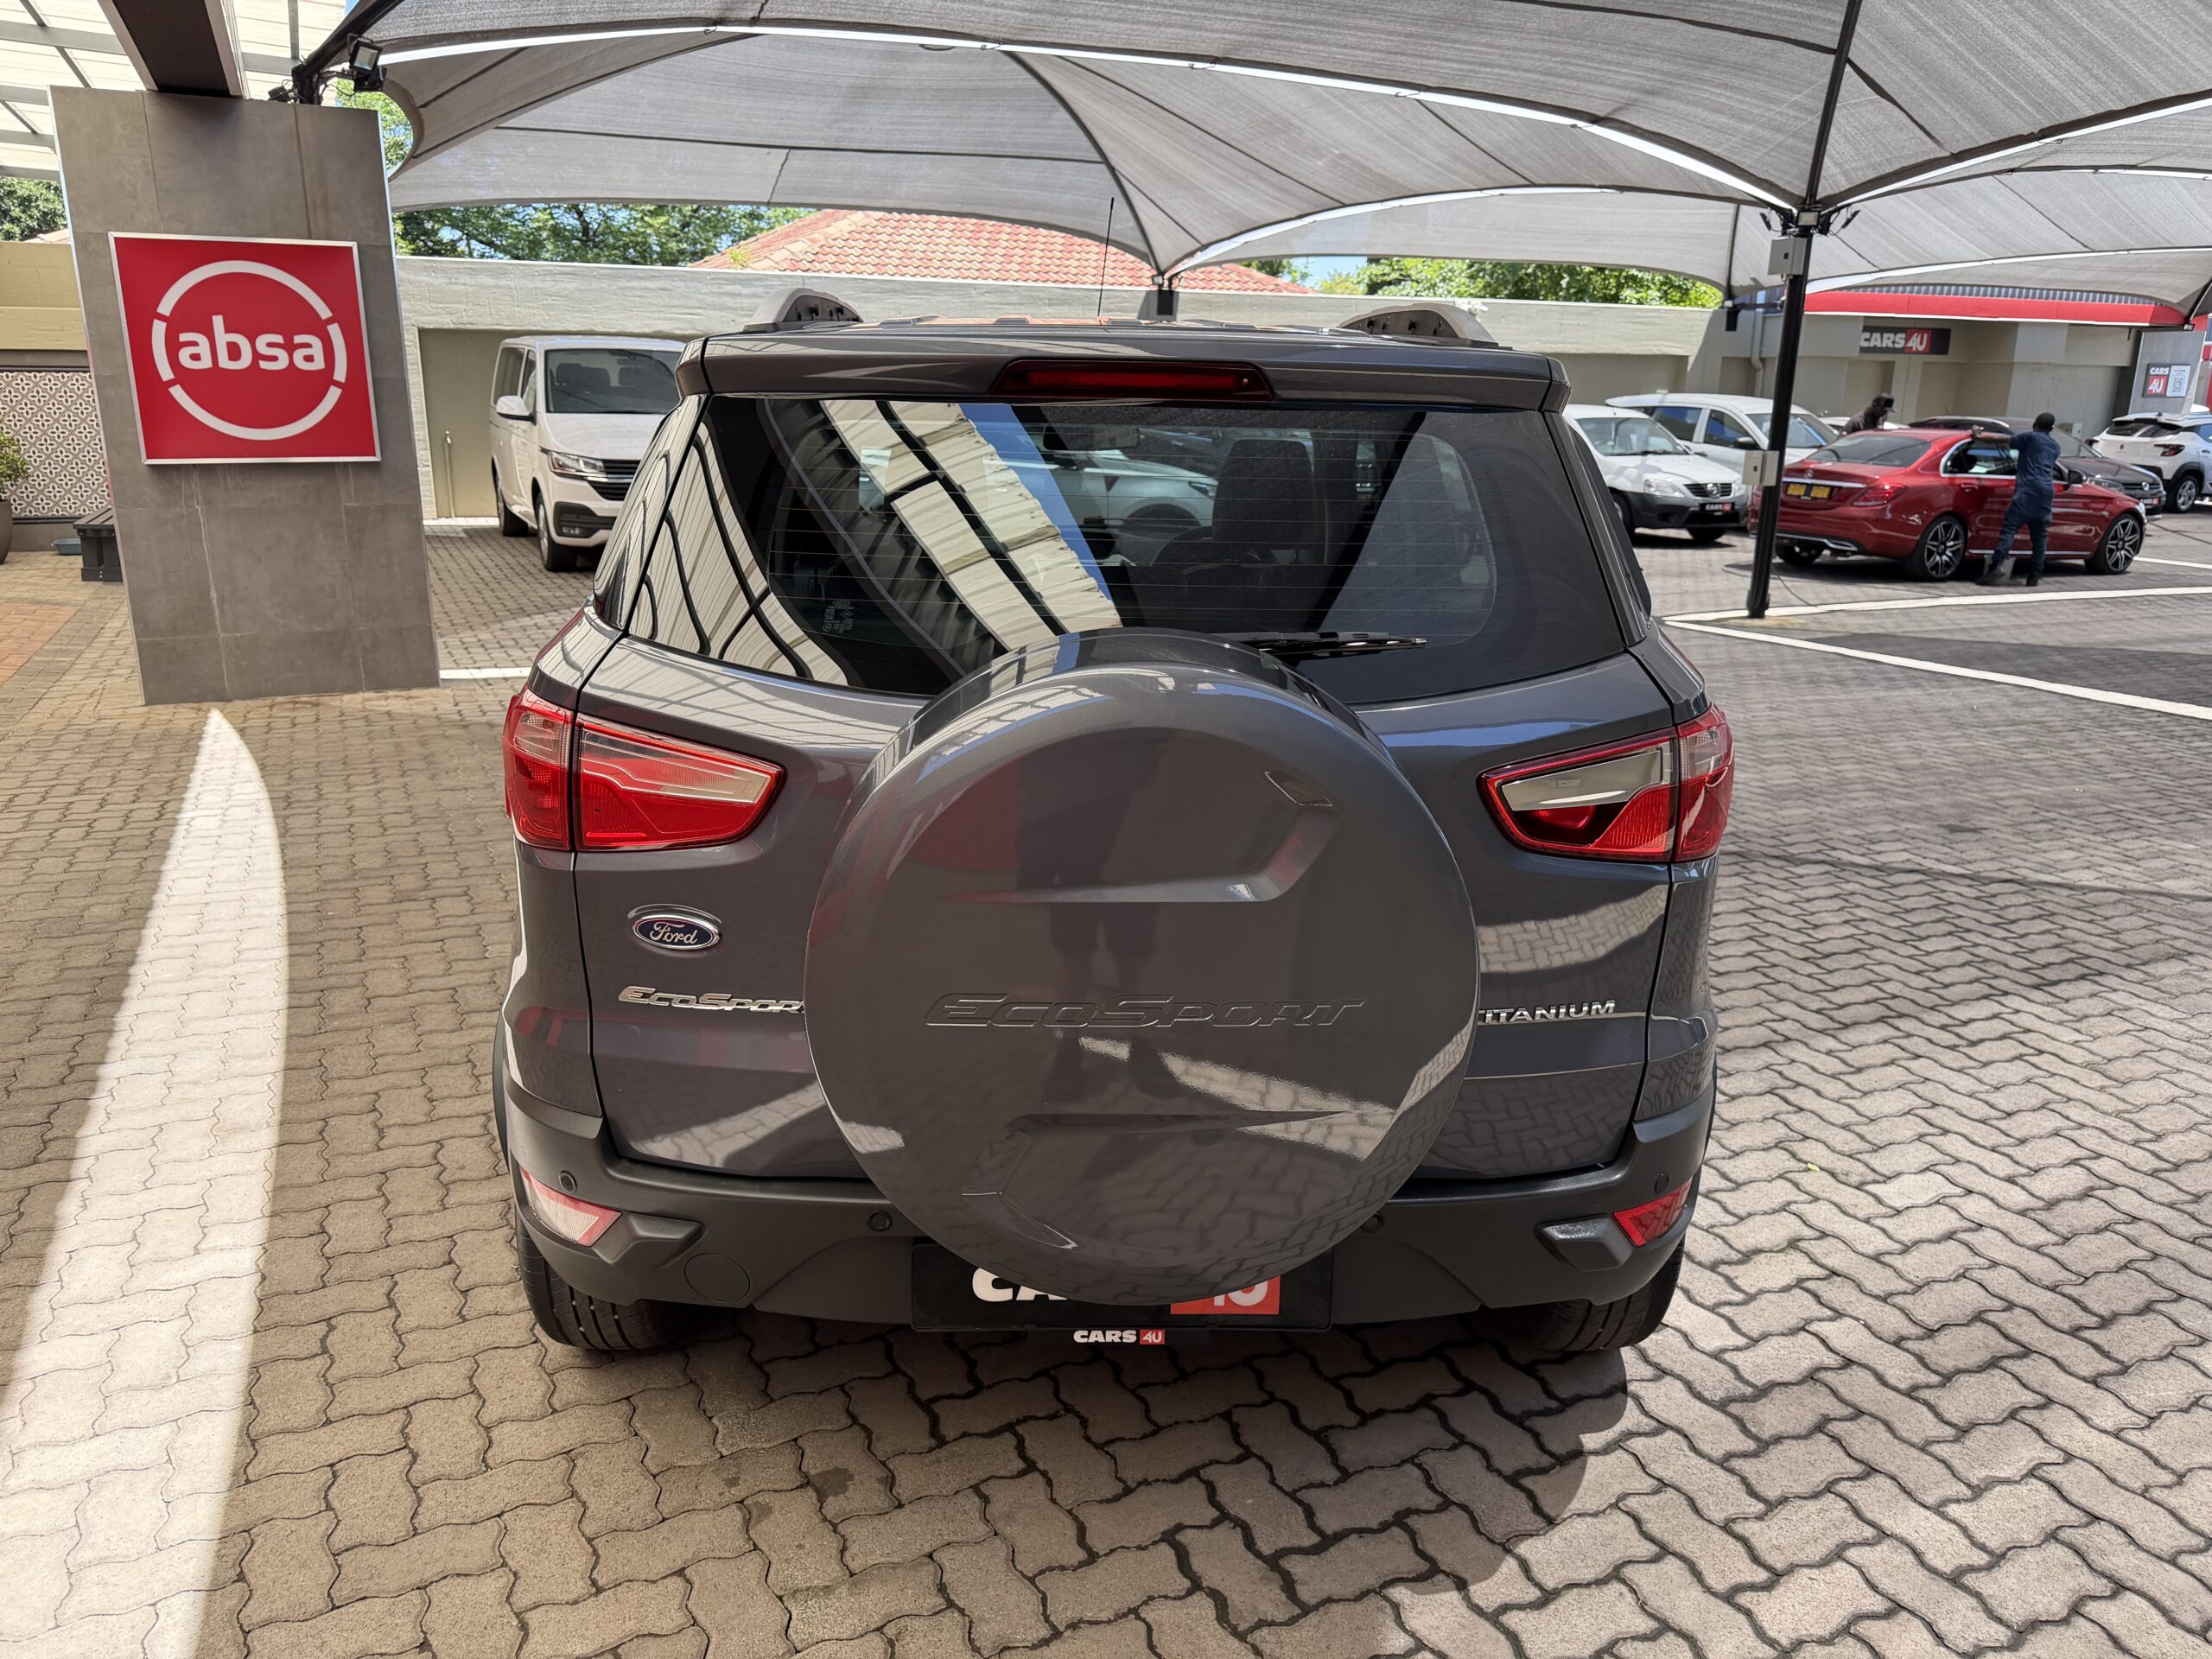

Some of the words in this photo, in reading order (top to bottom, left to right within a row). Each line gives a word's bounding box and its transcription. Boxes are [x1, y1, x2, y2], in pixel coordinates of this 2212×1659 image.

[178, 315, 326, 371] absa
[2149, 366, 2171, 376] CARS
[2147, 378, 2164, 393] 4U
[649, 921, 698, 944] Ford
